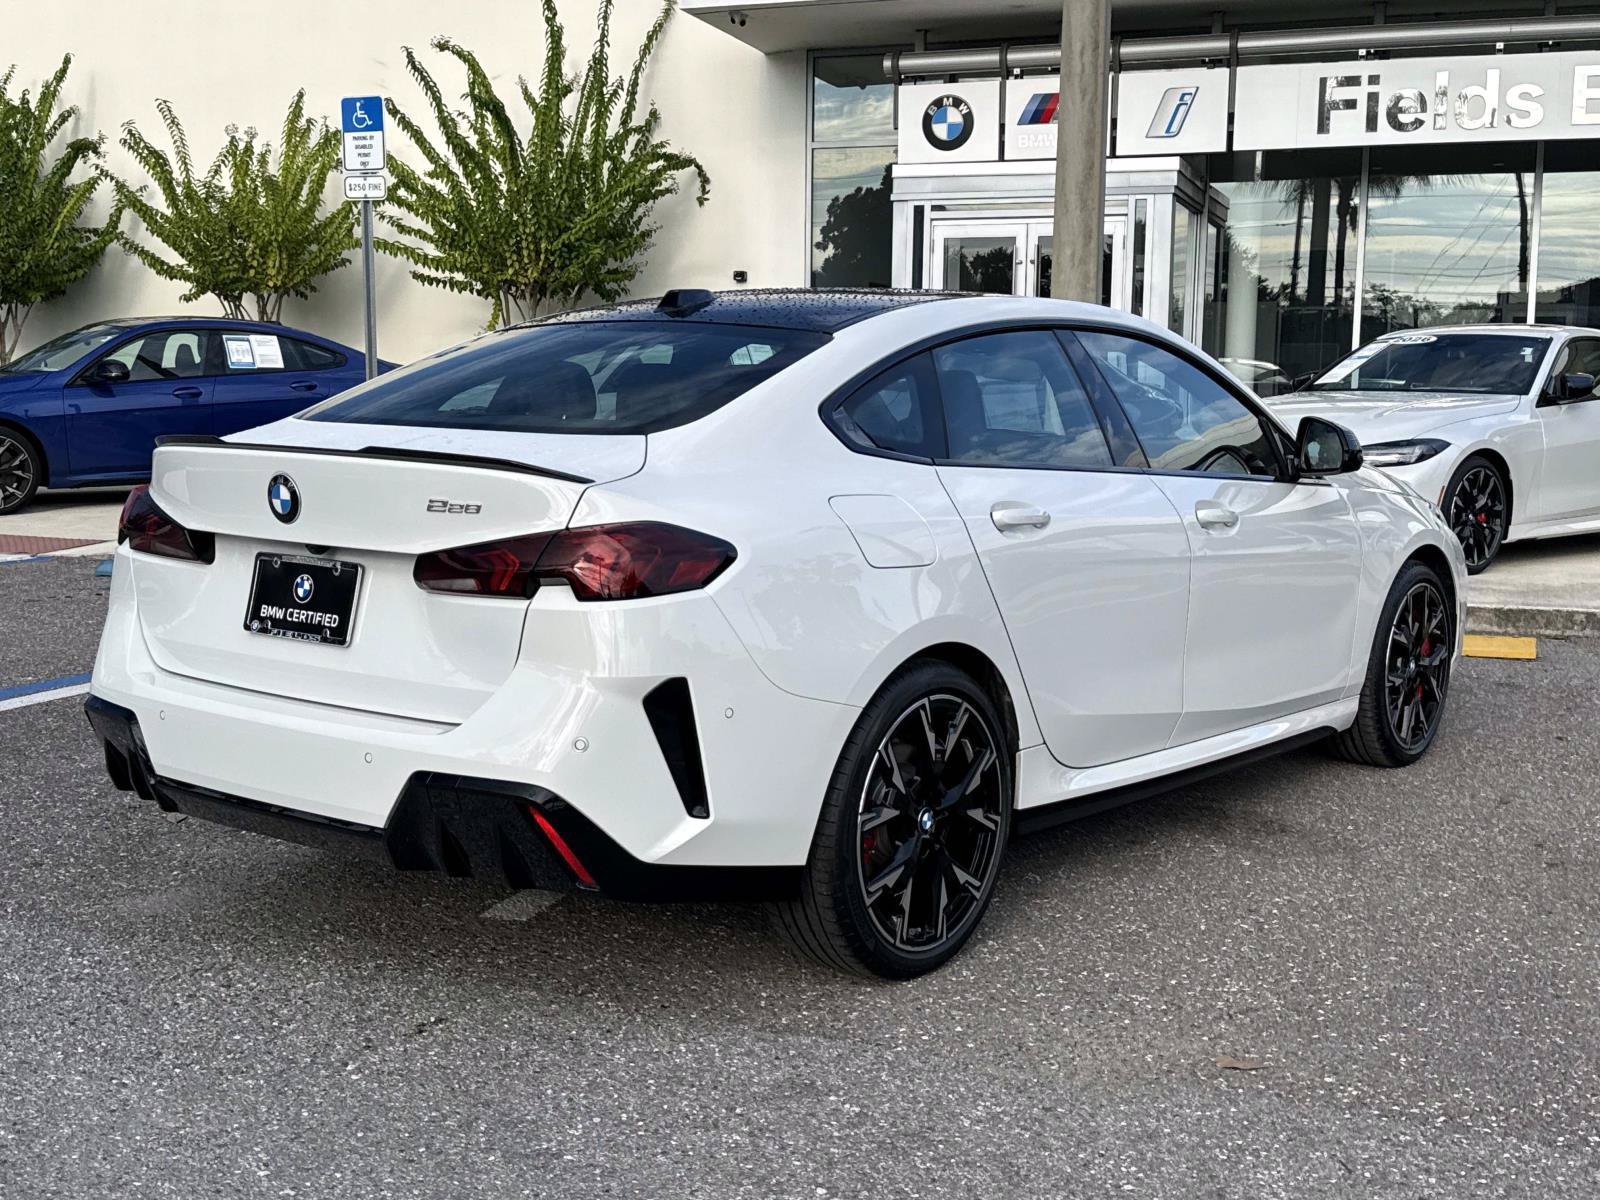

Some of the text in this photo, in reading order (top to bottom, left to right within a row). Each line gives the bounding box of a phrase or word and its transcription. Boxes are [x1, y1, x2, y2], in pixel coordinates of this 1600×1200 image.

[927, 97, 970, 116] BMW
[1316, 68, 1546, 135] Fields
[348, 183, 382, 191] $250 FINE
[426, 499, 482, 514] 228
[260, 604, 339, 628] BMW CERTIFIED
